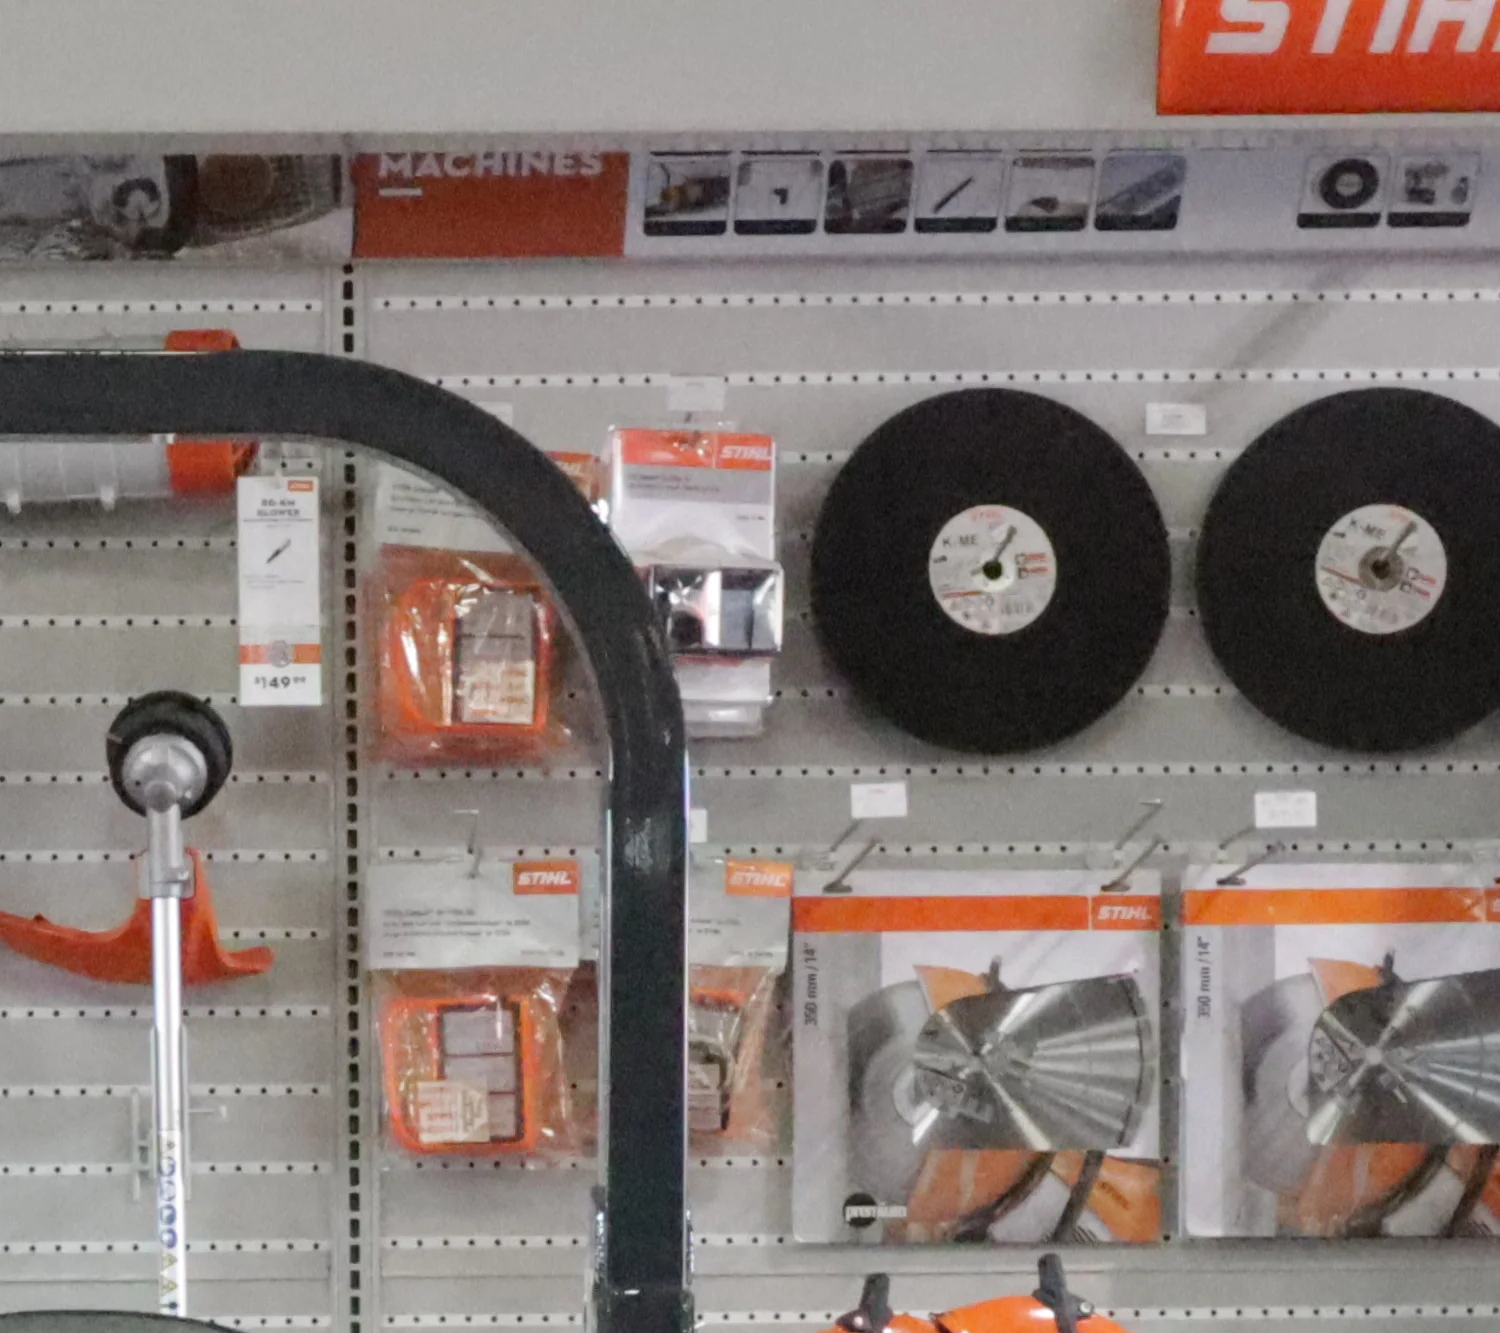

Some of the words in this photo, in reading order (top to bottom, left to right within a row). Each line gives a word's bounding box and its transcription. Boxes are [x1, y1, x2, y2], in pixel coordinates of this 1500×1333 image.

[378, 152, 604, 178] MACHINES
[720, 444, 773, 462] STIHL
[515, 870, 573, 887] STIHL
[1097, 905, 1152, 920] STIHL
